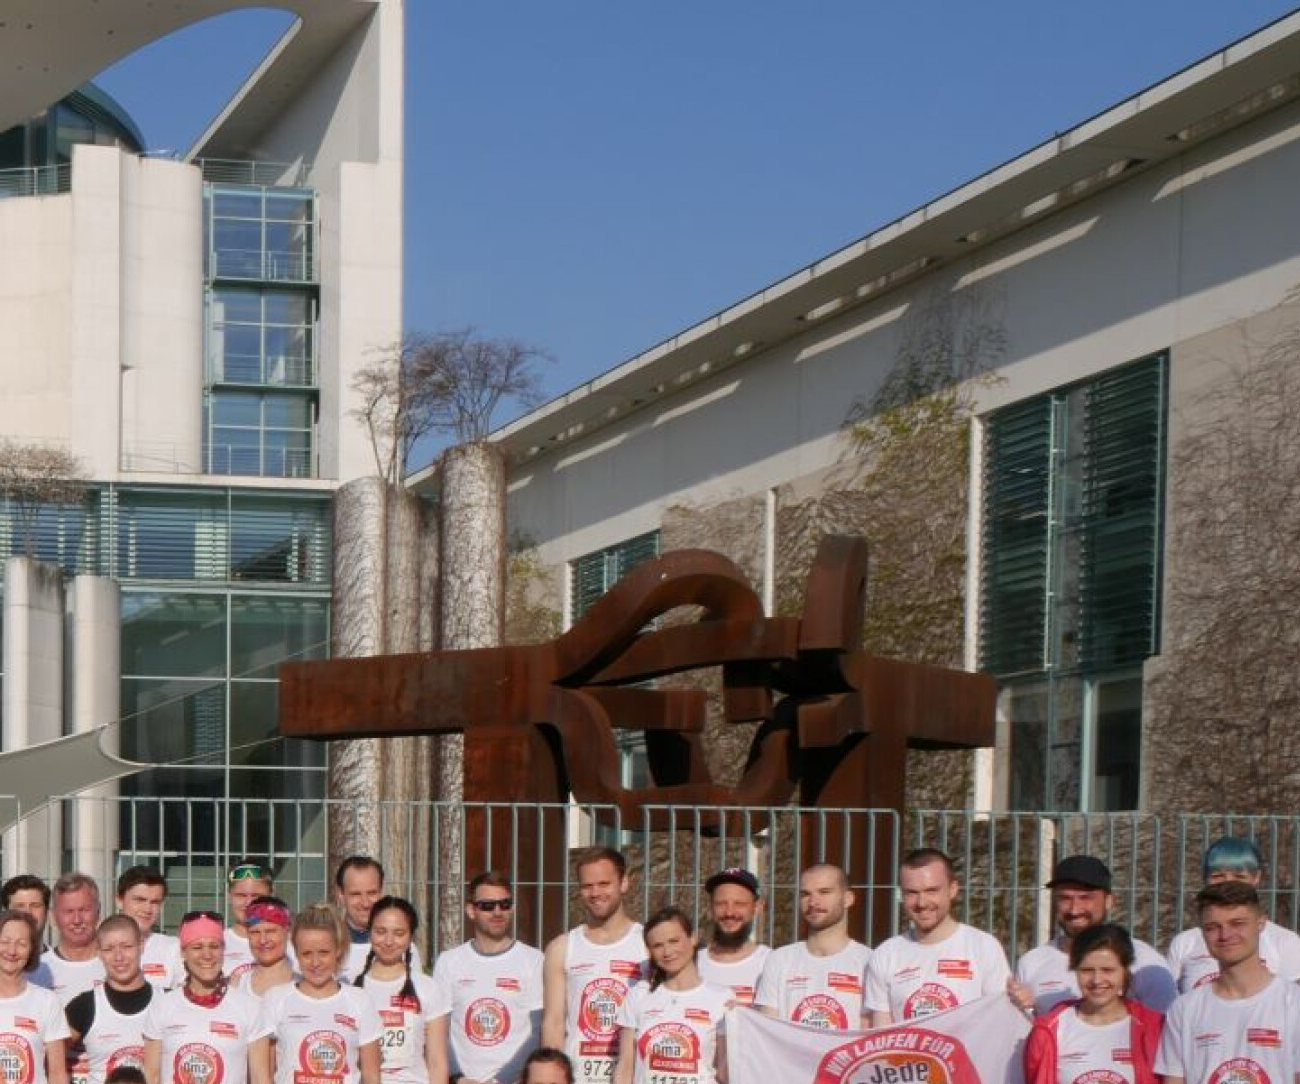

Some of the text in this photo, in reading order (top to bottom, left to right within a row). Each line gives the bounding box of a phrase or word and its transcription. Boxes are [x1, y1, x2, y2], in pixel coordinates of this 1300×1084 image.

[824, 1033, 955, 1076] WIR LAUFEN FÜR
[584, 1060, 618, 1077] 972
[870, 1062, 928, 1084] Jede
